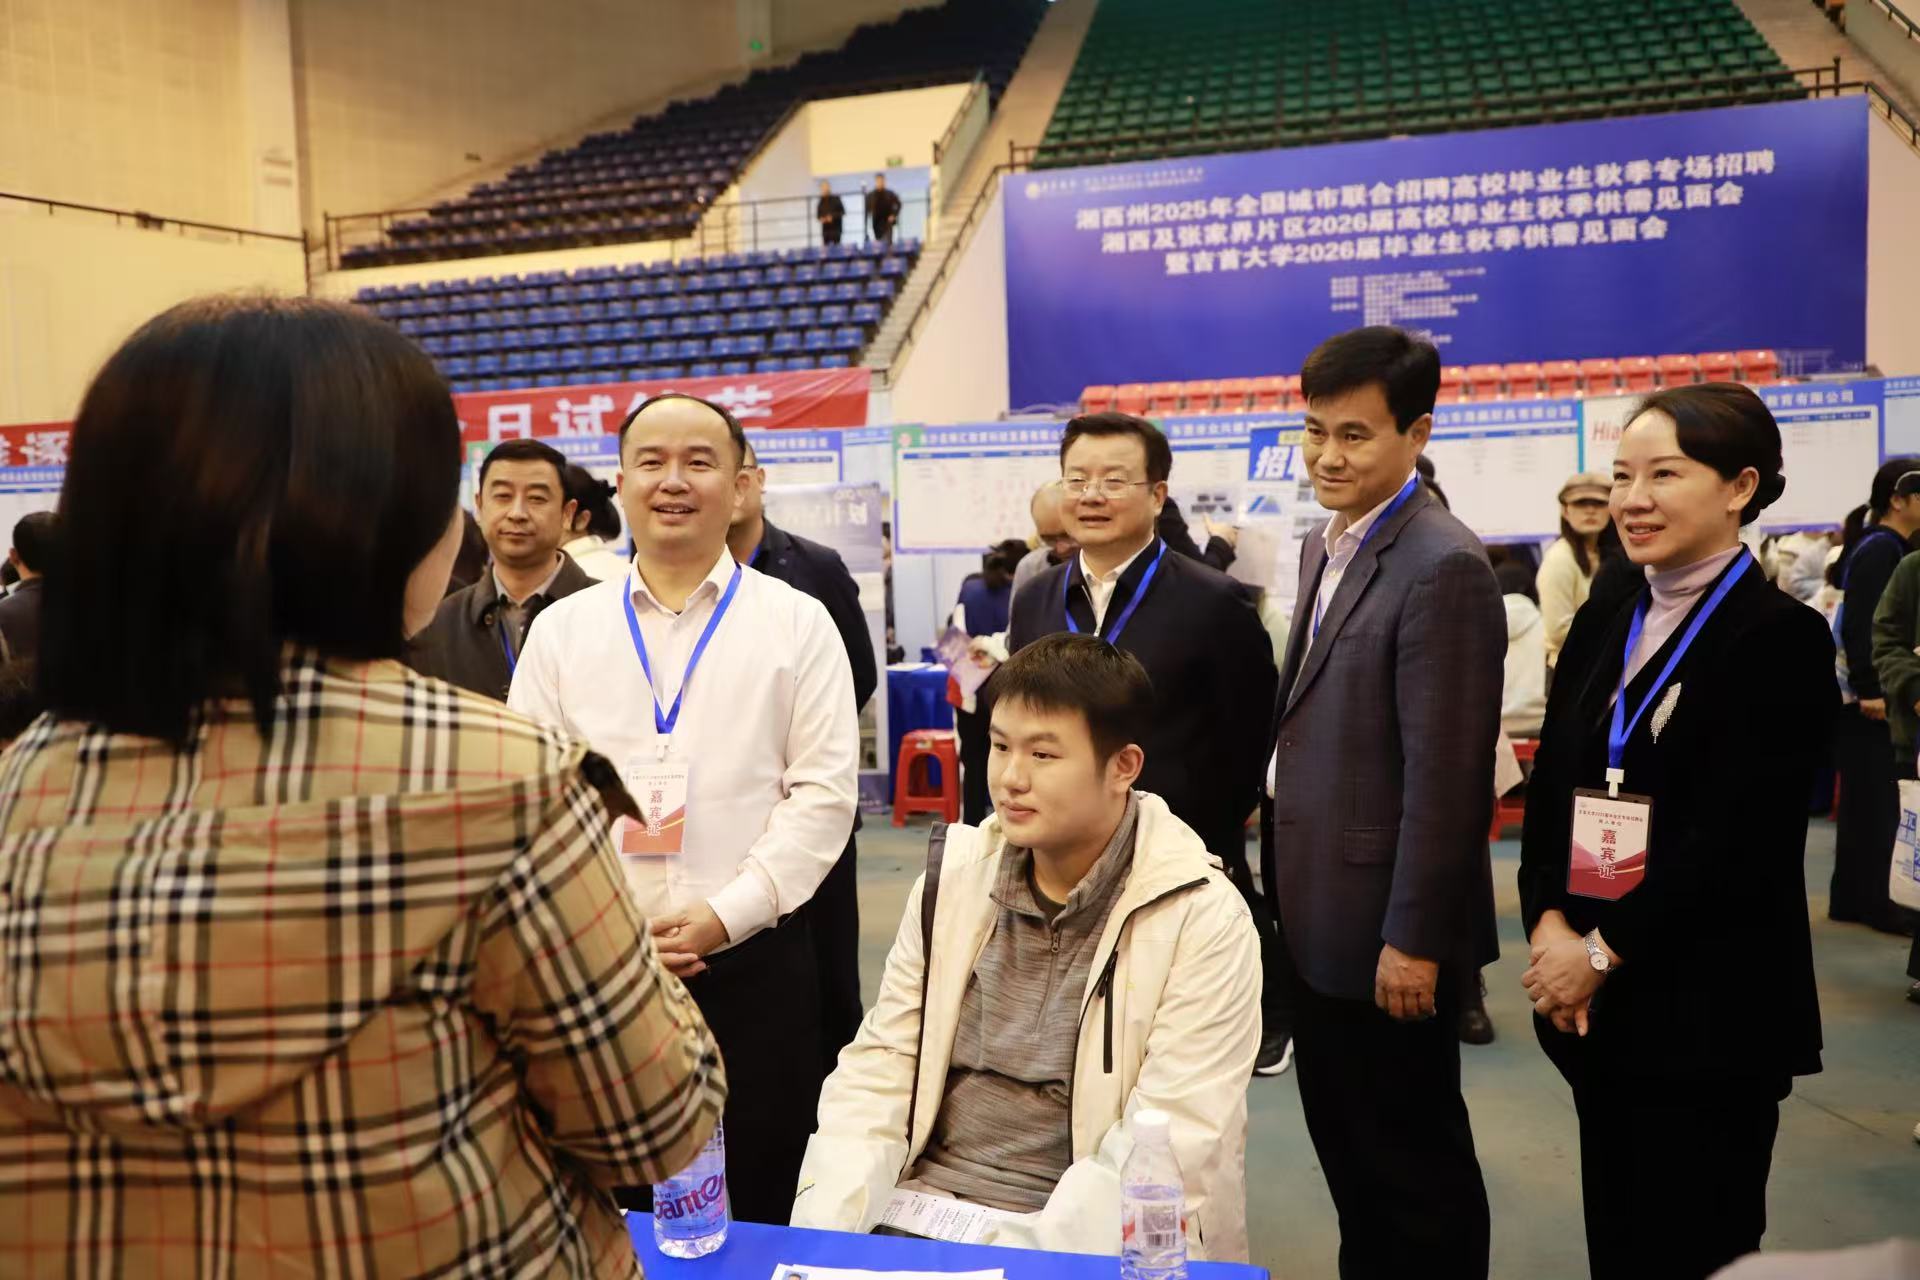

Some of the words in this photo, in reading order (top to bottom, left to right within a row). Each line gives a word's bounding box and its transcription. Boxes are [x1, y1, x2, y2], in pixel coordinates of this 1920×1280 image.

[1076, 149, 1775, 230] 湘西州2025年全国城市联合招聘高校毕业生秋季专场招聘
[1101, 181, 1744, 253] 湘西及张家界片区2026届高校毕业生秋季供需见面会
[1165, 215, 1668, 275] 暨吉首大学2026届毕业生秋季供需见面会
[1599, 829, 1617, 880] 嘉宾证
